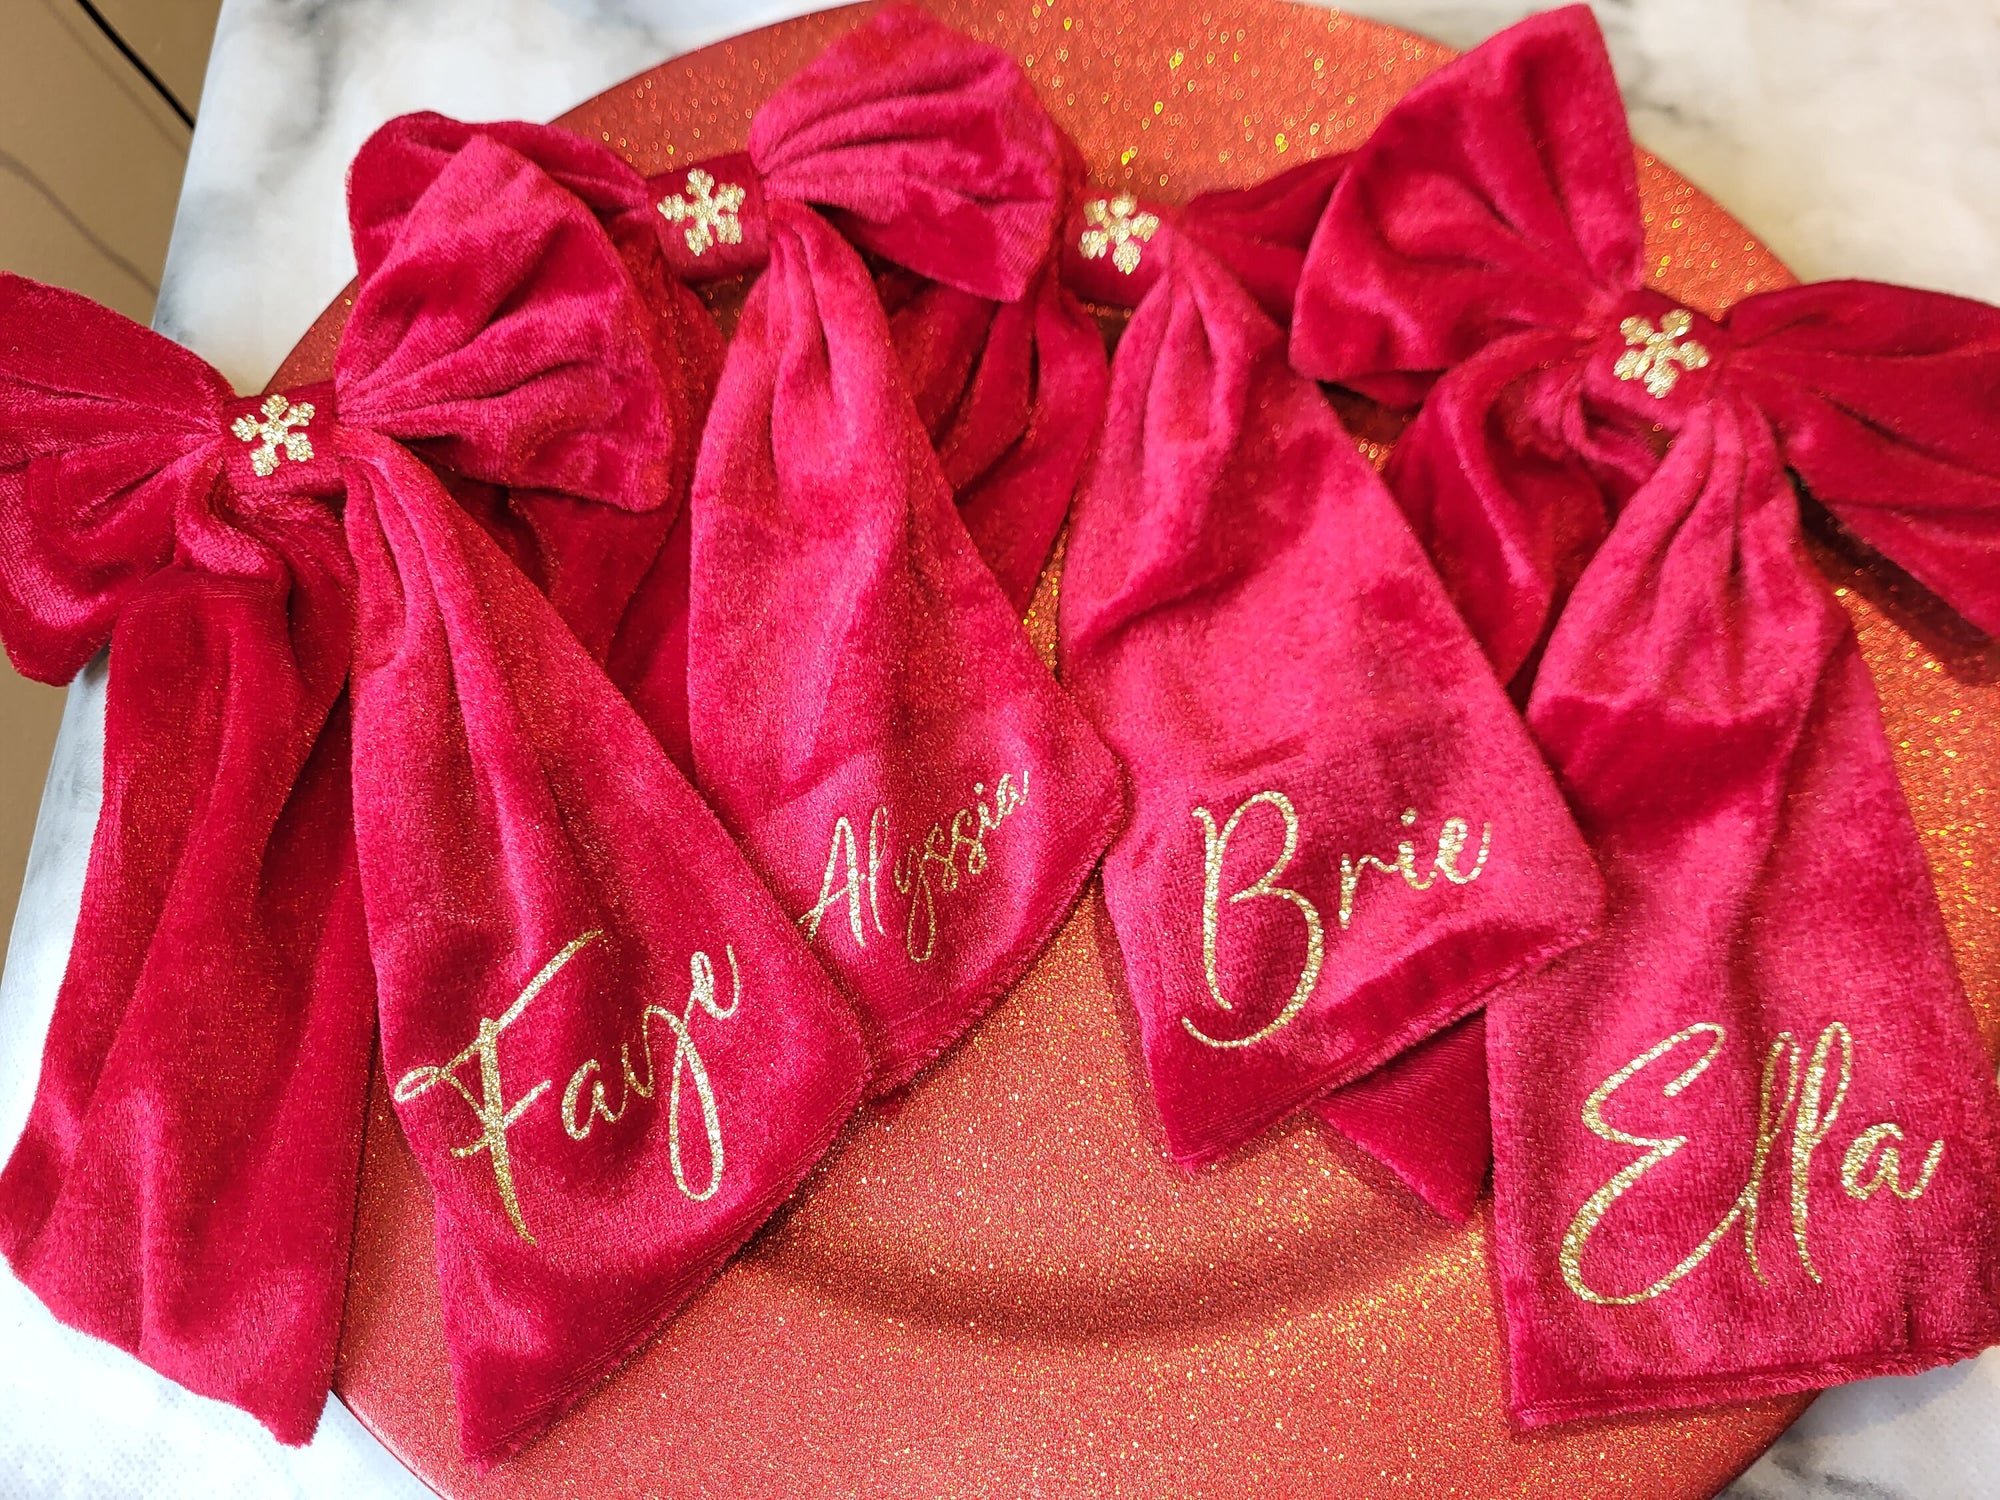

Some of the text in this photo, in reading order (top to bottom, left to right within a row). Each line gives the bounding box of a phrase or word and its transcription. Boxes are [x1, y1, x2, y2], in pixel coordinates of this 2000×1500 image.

[796, 769, 1030, 963] Alyssia
[1181, 791, 1491, 1047] Brie
[394, 929, 740, 1244] Faye
[1560, 1022, 1944, 1305] Ella
